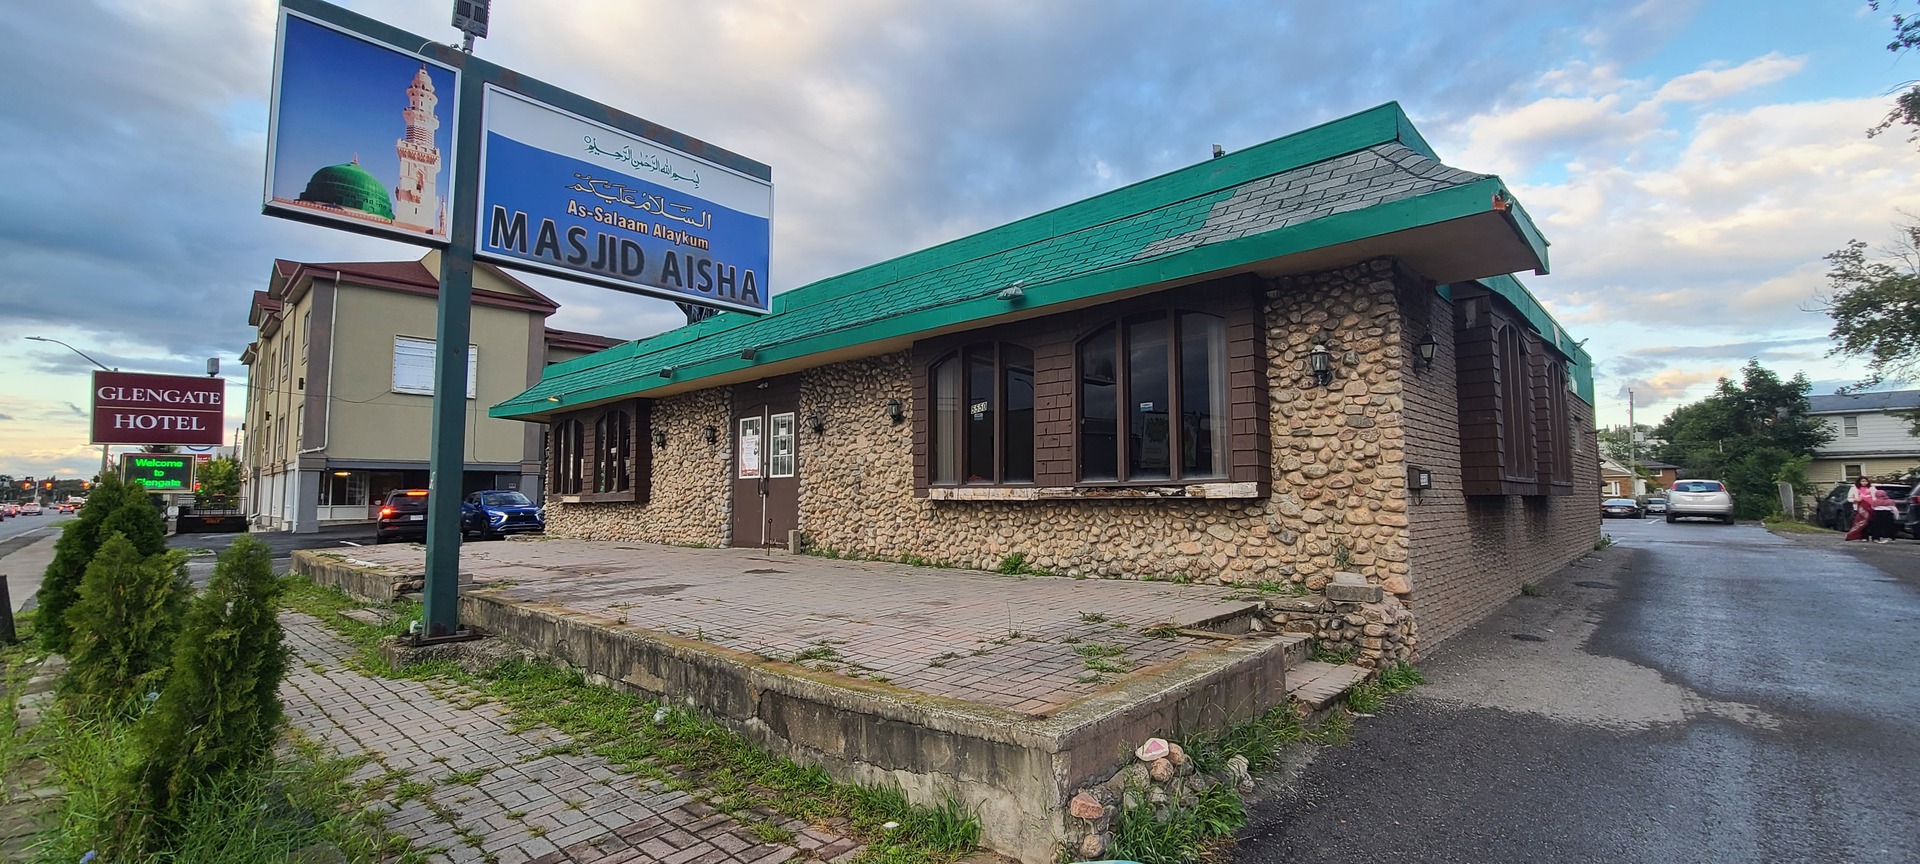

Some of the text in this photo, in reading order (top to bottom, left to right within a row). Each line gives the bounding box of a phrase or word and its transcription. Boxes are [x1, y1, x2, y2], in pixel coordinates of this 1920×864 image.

[566, 199, 710, 250] As-Salaam Alaykum
[489, 204, 761, 305] MASJID AISHA
[98, 387, 221, 405] GLENGATE
[114, 413, 206, 431] HOTEL
[135, 459, 183, 467] Welcome
[154, 469, 164, 477] to
